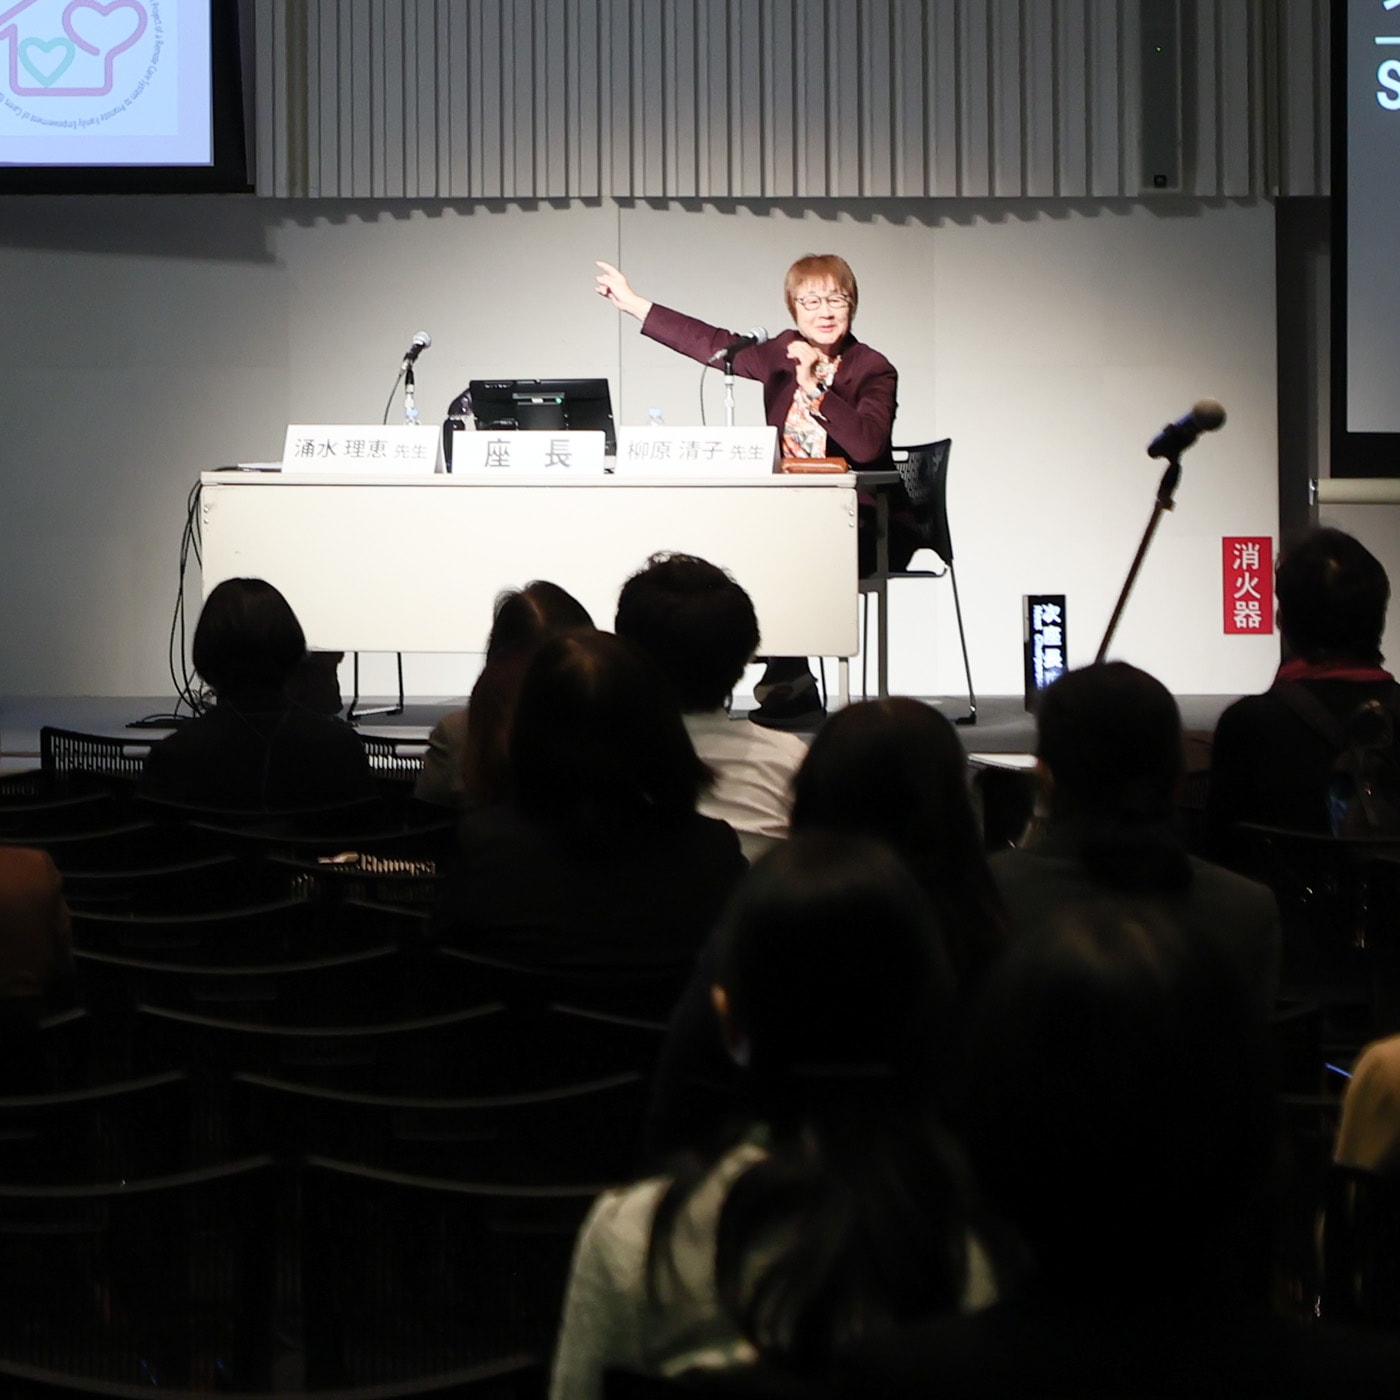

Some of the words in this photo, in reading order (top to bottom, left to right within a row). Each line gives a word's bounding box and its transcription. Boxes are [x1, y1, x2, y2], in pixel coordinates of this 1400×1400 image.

[294, 438, 338, 459] 涌水
[343, 439, 388, 459] 理恵
[393, 443, 427, 459] 先生
[627, 440, 672, 460] 柳原
[679, 440, 724, 460] 清子
[730, 445, 764, 460] 先生
[1232, 542, 1262, 630] 消火器
